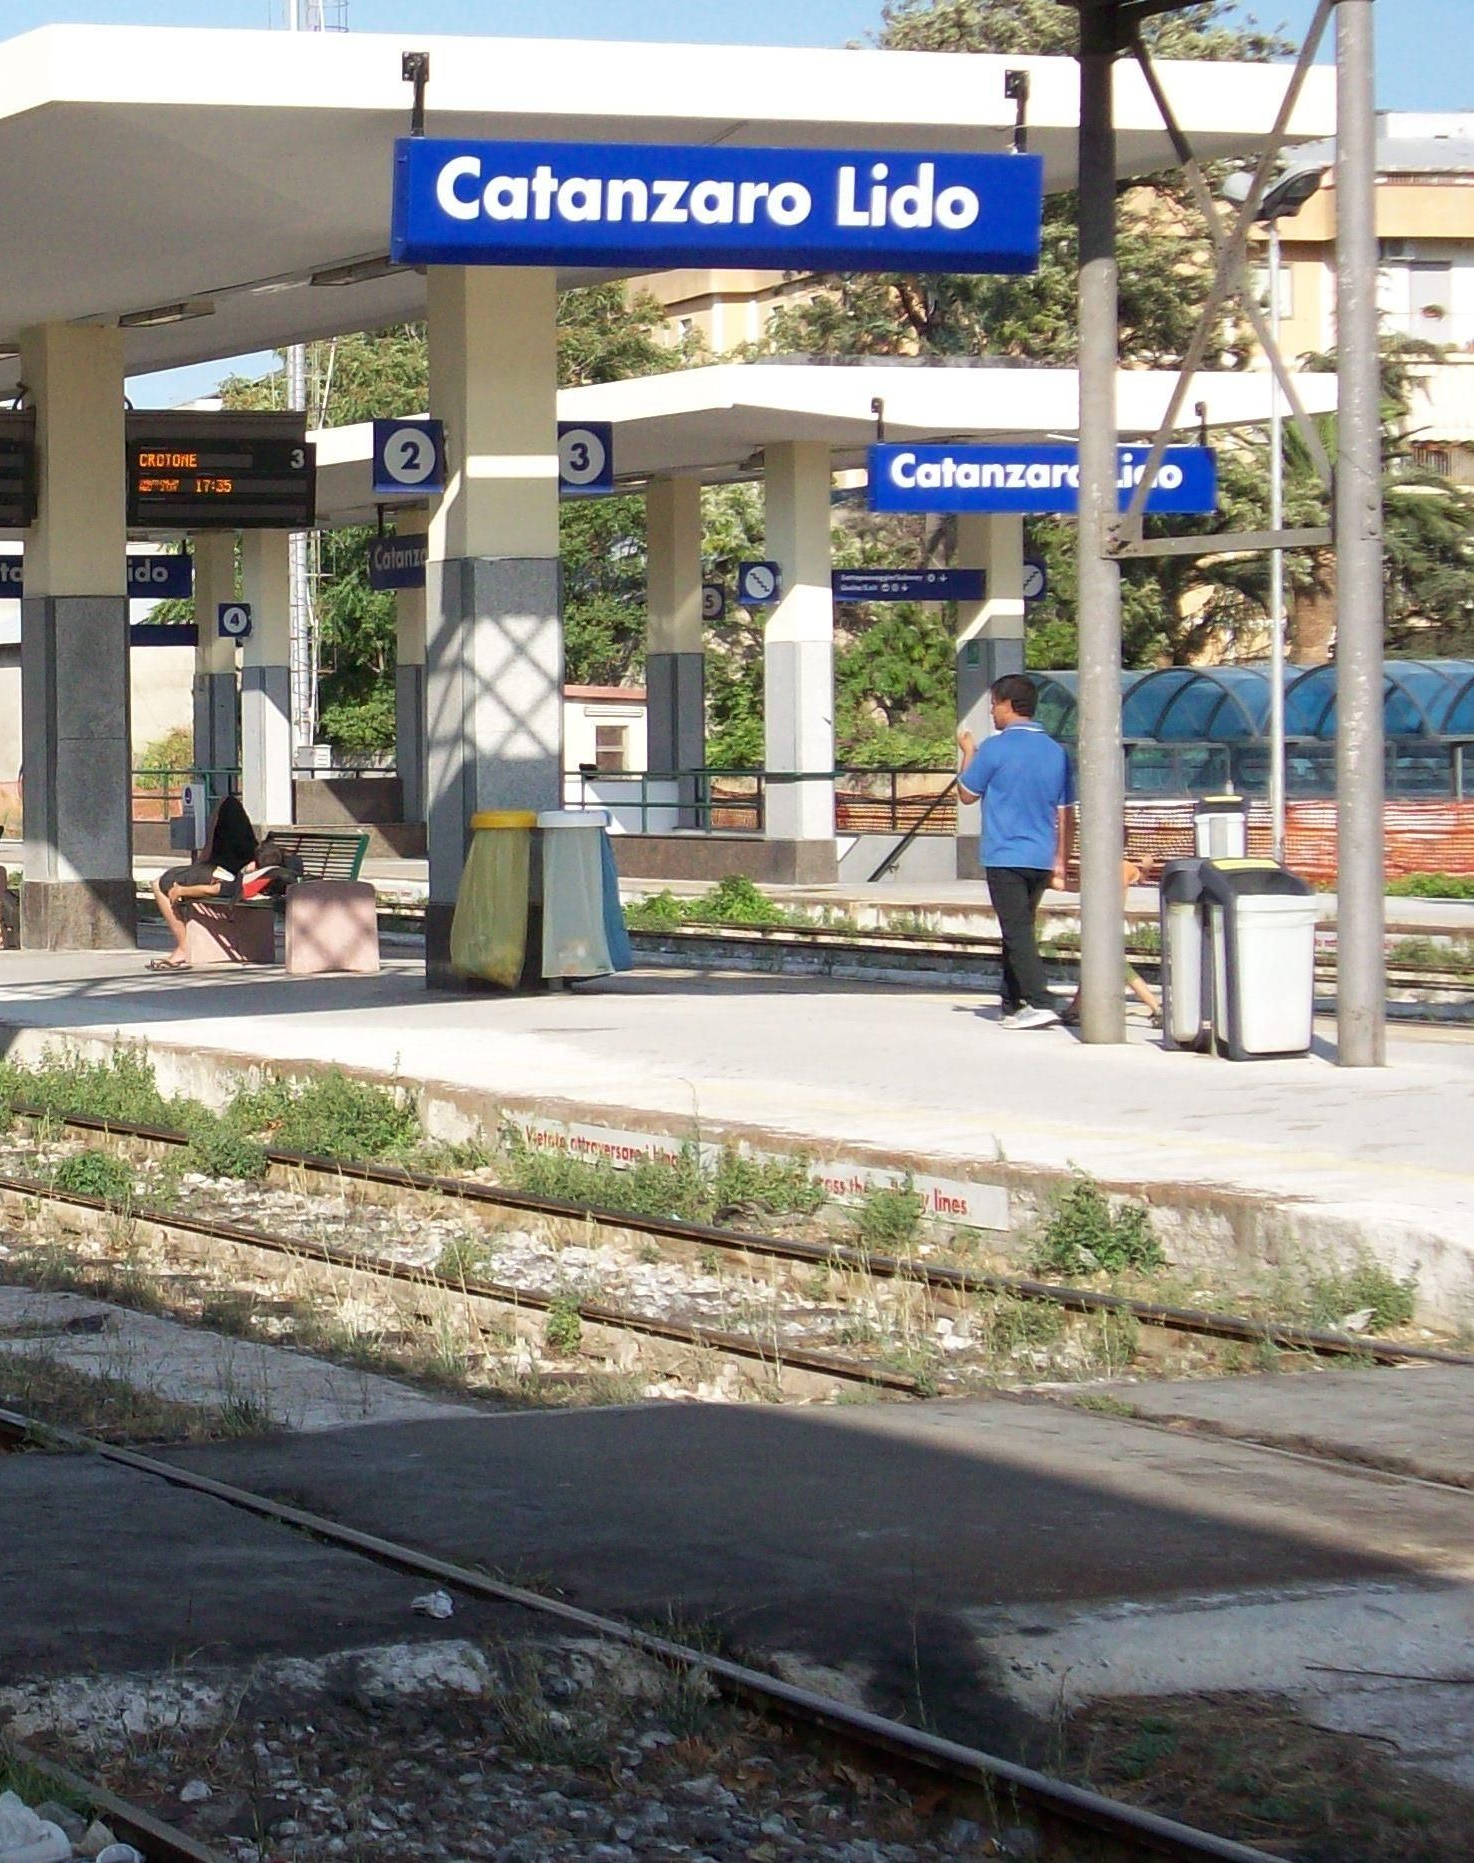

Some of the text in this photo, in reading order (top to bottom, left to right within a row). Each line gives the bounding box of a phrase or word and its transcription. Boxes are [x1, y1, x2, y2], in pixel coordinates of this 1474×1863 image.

[436, 156, 980, 229] Catanzaro Lido
[290, 449, 305, 469] 3
[400, 441, 420, 470] 2
[569, 442, 590, 471] 3
[195, 479, 232, 493] 17:35
[230, 613, 240, 627] 4
[934, 1188, 967, 1216] lines
